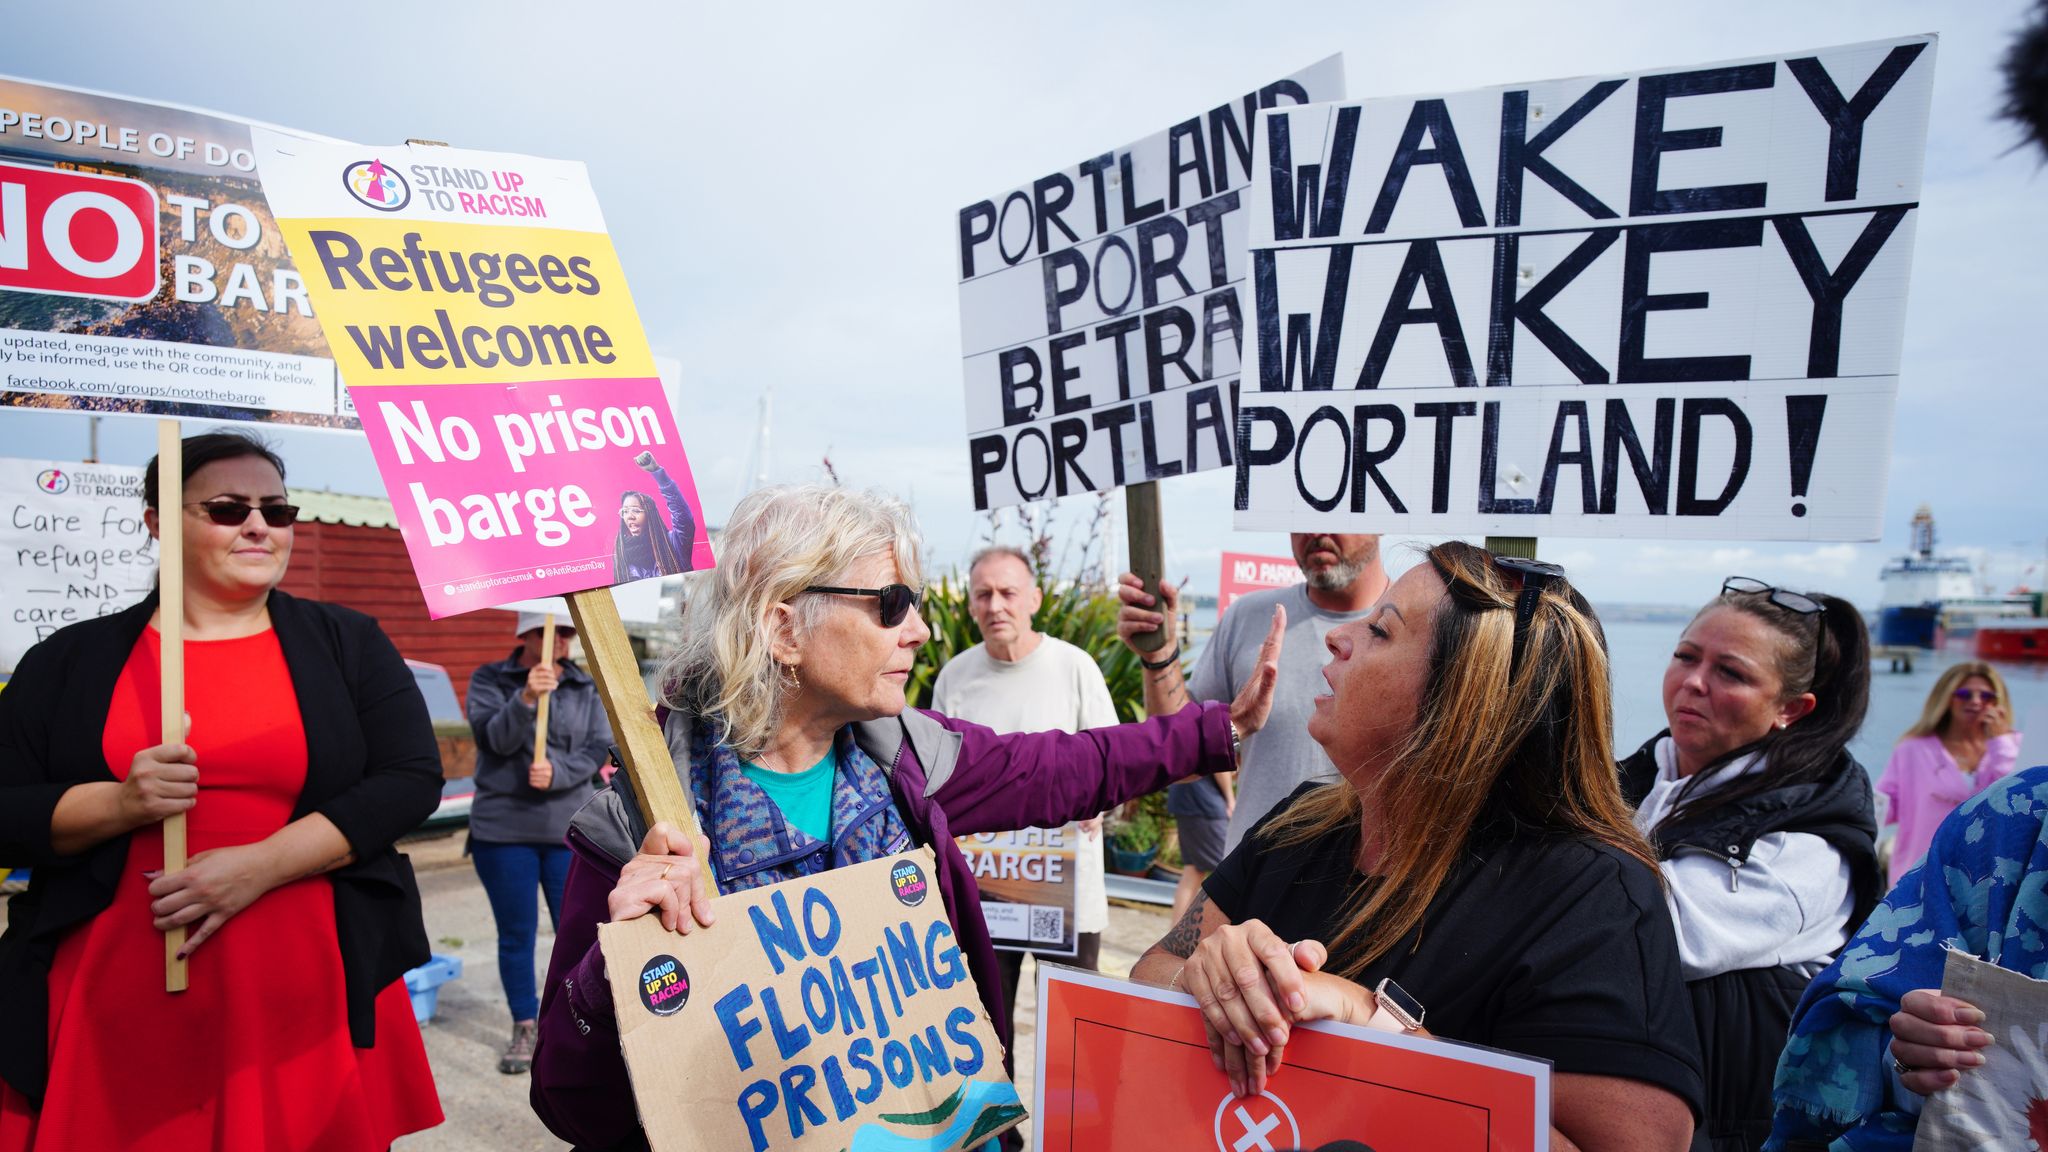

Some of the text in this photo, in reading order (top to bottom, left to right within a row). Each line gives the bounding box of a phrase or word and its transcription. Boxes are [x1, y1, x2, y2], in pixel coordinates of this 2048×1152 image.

[0, 108, 139, 152] PEOPLE
[148, 133, 195, 160] OF
[1267, 42, 1929, 240] WAKEY
[410, 165, 524, 192] STAND UP
[960, 79, 1309, 279] PORTLAN
[419, 189, 547, 218] TO RACISM
[166, 194, 262, 250] TO
[309, 230, 601, 308] Refugees
[1043, 190, 1241, 334] PORT
[1253, 204, 1910, 392] WAKEY
[4, 337, 302, 372] updated, engage with the community, and
[345, 309, 617, 370] welcome
[17, 350, 36, 363] be
[40, 352, 110, 368] informed,
[114, 359, 138, 370] use
[142, 360, 165, 372] the
[169, 361, 189, 373] QR
[193, 365, 226, 377] code
[230, 370, 243, 378] or
[247, 369, 271, 381] link
[274, 372, 317, 385] below.
[7, 374, 266, 405] facebook.com/groups/notothebarge
[378, 394, 666, 473] No prison
[73, 471, 138, 485] STAND UP
[75, 484, 92, 495] TO
[13, 505, 81, 532] Care
[408, 482, 597, 547] barge
[17, 544, 155, 580] refugees
[456, 560, 605, 594] standuptoracismuk @AntiRacismDay
[1234, 560, 1256, 580] NO
[66, 584, 119, 600] AND
[14, 606, 79, 623] care
[893, 865, 916, 879] STAND
[895, 874, 918, 888] UP TO
[898, 881, 926, 896] RACISM
[748, 887, 841, 975] NO
[643, 961, 675, 983] STAND
[646, 972, 678, 994] UP TO
[650, 978, 688, 1006] RACISM
[714, 920, 967, 1072] FLOATING
[737, 1006, 985, 1152] PRISONS
